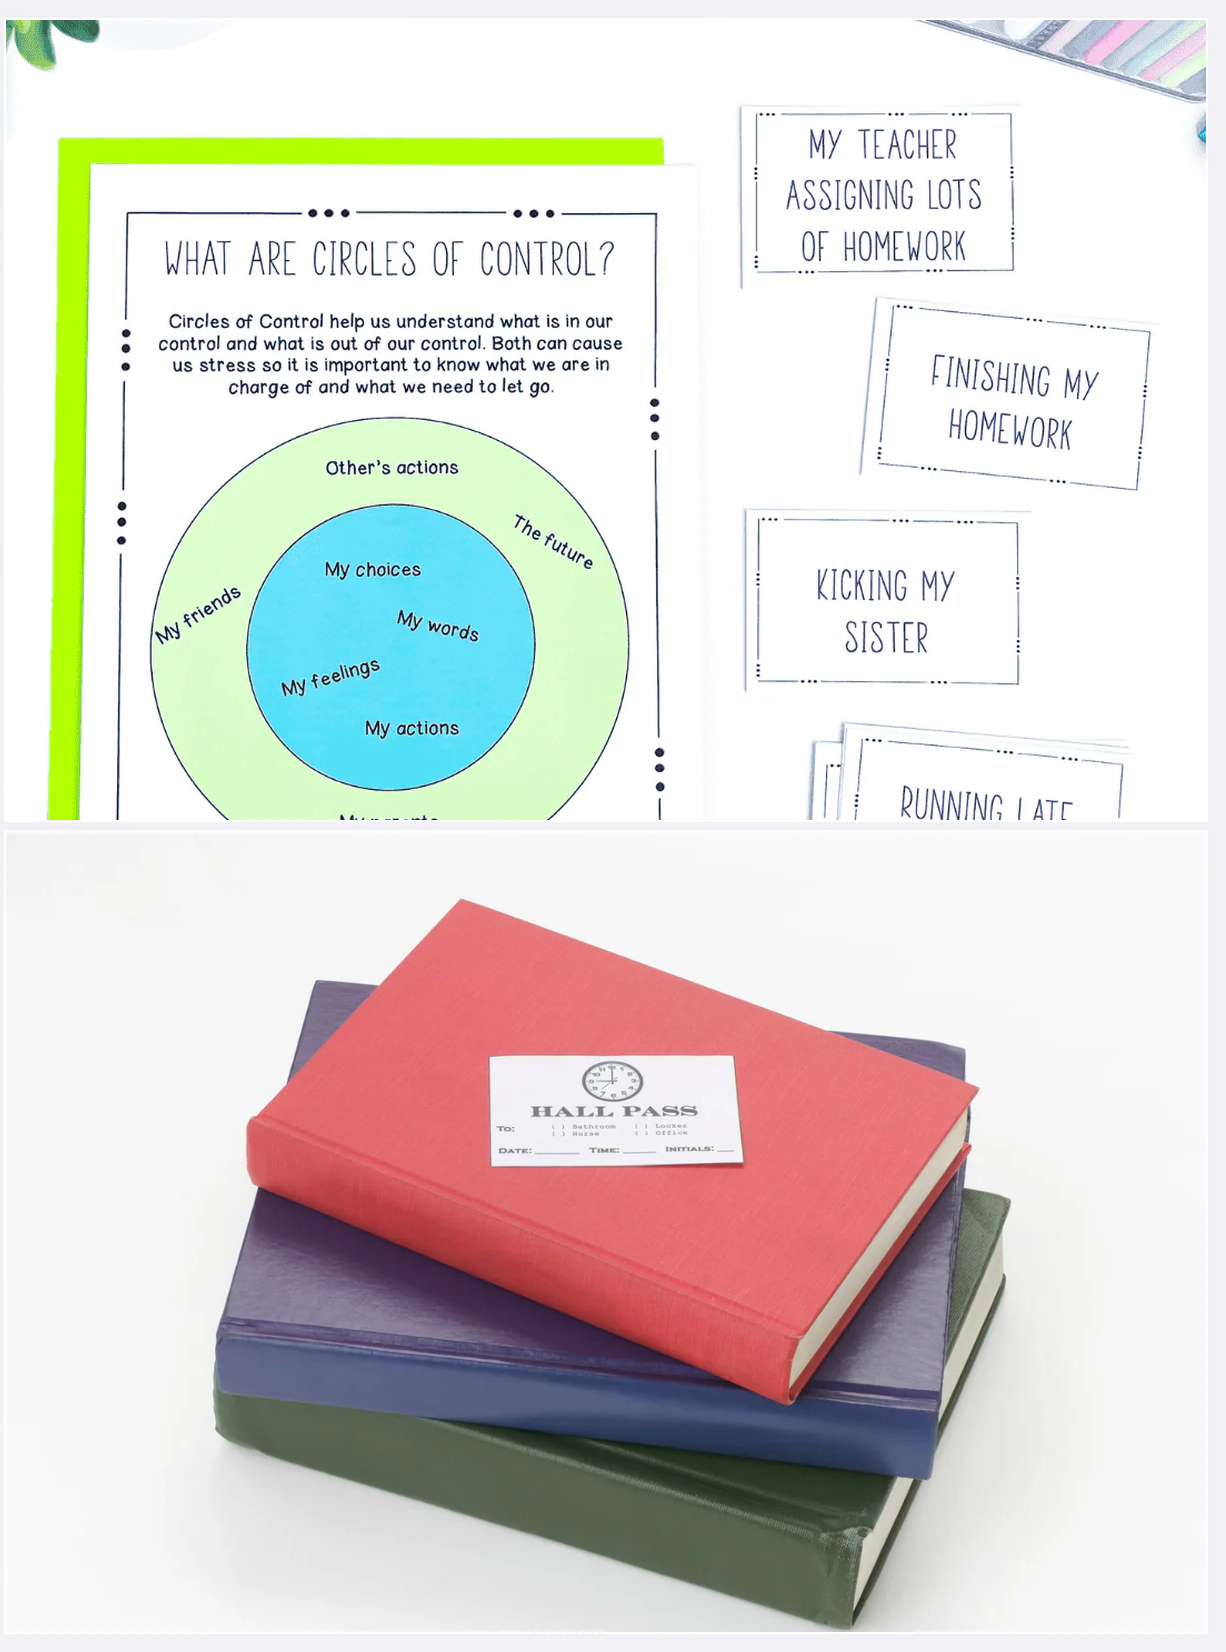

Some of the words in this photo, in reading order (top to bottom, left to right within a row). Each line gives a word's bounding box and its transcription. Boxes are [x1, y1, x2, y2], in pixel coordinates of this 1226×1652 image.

[809, 128, 843, 160] MY
[857, 128, 957, 160] TEACHER
[786, 178, 914, 211] ASSIGNING
[928, 178, 982, 210] LOTS
[165, 240, 232, 276] WHAT
[248, 240, 296, 276] ARE
[313, 240, 417, 277] CIRCLES
[433, 240, 464, 277] OF
[480, 240, 615, 277] CONTROL?
[801, 230, 830, 262] OF
[844, 229, 966, 262] HOMEWORK
[168, 312, 230, 330] Circles
[235, 313, 254, 330] of
[259, 312, 324, 329] Control
[329, 312, 365, 332] help
[370, 317, 391, 329] us
[396, 312, 495, 329] understand
[499, 313, 541, 329] what
[546, 313, 561, 329] is
[565, 313, 581, 329] in
[585, 316, 614, 329] our
[158, 334, 221, 352] control
[226, 335, 258, 352] and
[263, 335, 306, 352] what
[310, 336, 325, 352] is
[330, 336, 359, 352] out
[363, 335, 382, 352] of
[387, 338, 416, 352] our
[420, 334, 486, 352] control.
[491, 335, 532, 351] Both
[536, 338, 568, 351] can
[572, 338, 623, 351] cause
[172, 360, 194, 373] us
[199, 357, 257, 373] stress
[261, 360, 283, 373] so
[287, 357, 299, 372] it
[304, 357, 319, 373] is
[324, 357, 409, 376] important
[412, 357, 432, 373] to
[436, 356, 481, 373] know
[485, 356, 527, 372] what
[531, 360, 556, 372] we
[561, 359, 590, 372] are
[595, 356, 610, 372] in
[931, 353, 1051, 398] FINISHING
[1063, 367, 1100, 401] MY
[228, 379, 290, 400] charge
[294, 379, 314, 395] of
[318, 378, 350, 395] and
[355, 378, 397, 395] what
[402, 382, 427, 394] we
[431, 378, 474, 394] need
[478, 379, 497, 394] to
[501, 378, 524, 394] let
[529, 381, 555, 399] go.
[948, 407, 1073, 451] HOMEWORK
[325, 459, 391, 476] Other's
[396, 459, 459, 476] actions
[512, 513, 542, 542] The
[543, 530, 595, 571] future
[325, 561, 351, 581] My
[355, 561, 422, 578] choices
[817, 567, 907, 602] KICKING
[921, 570, 956, 602] MY
[155, 618, 181, 646] My
[183, 585, 242, 628] friends
[396, 609, 424, 632] My
[428, 620, 479, 642] words
[845, 620, 928, 654] SISTER
[281, 678, 306, 697] My
[310, 659, 381, 689] feelings
[365, 719, 391, 740] My
[396, 720, 460, 736] actions
[900, 784, 1003, 821] RUNNING
[530, 1105, 615, 1118] HALL
[622, 1105, 700, 1118] PASS
